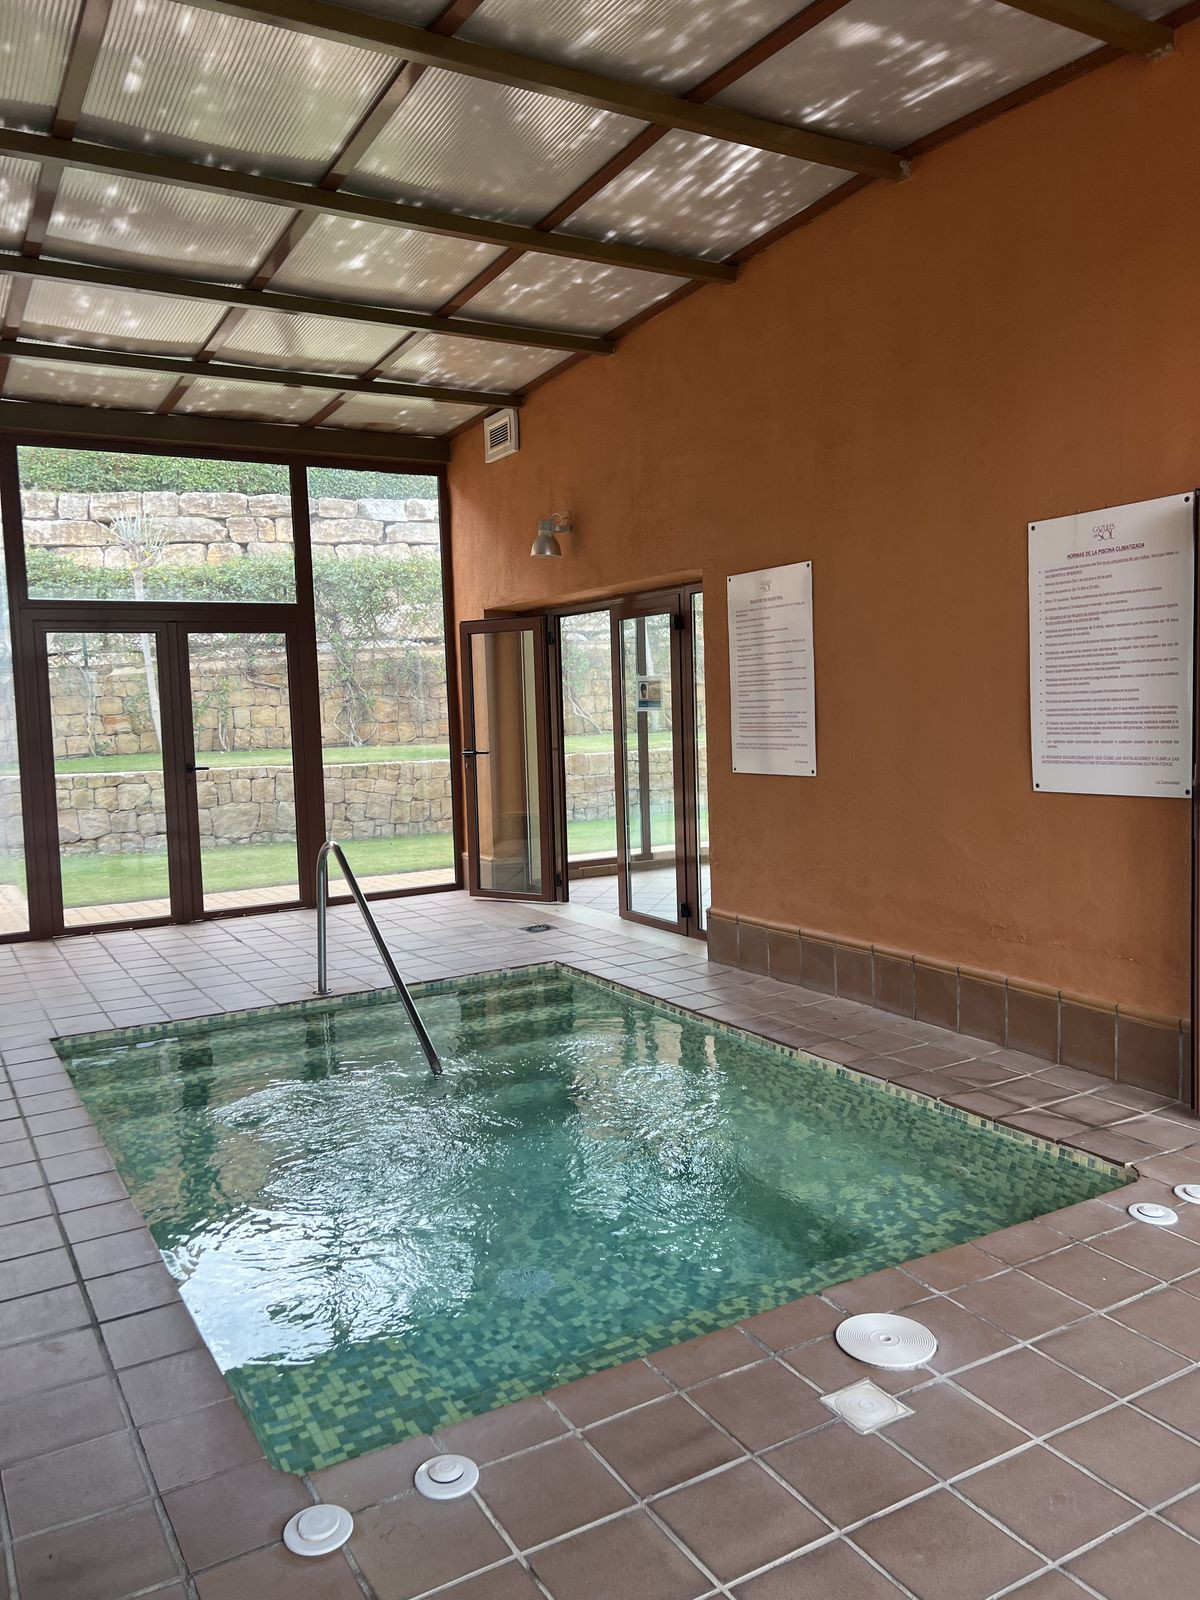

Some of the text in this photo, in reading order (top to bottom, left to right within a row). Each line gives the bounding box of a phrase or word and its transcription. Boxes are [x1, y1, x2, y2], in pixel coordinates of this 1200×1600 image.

[1097, 529, 1115, 541] SOL
[1066, 552, 1085, 560] NORMAS
[1098, 546, 1115, 555] PISCINA
[1116, 542, 1145, 552] CLIMATIZADA
